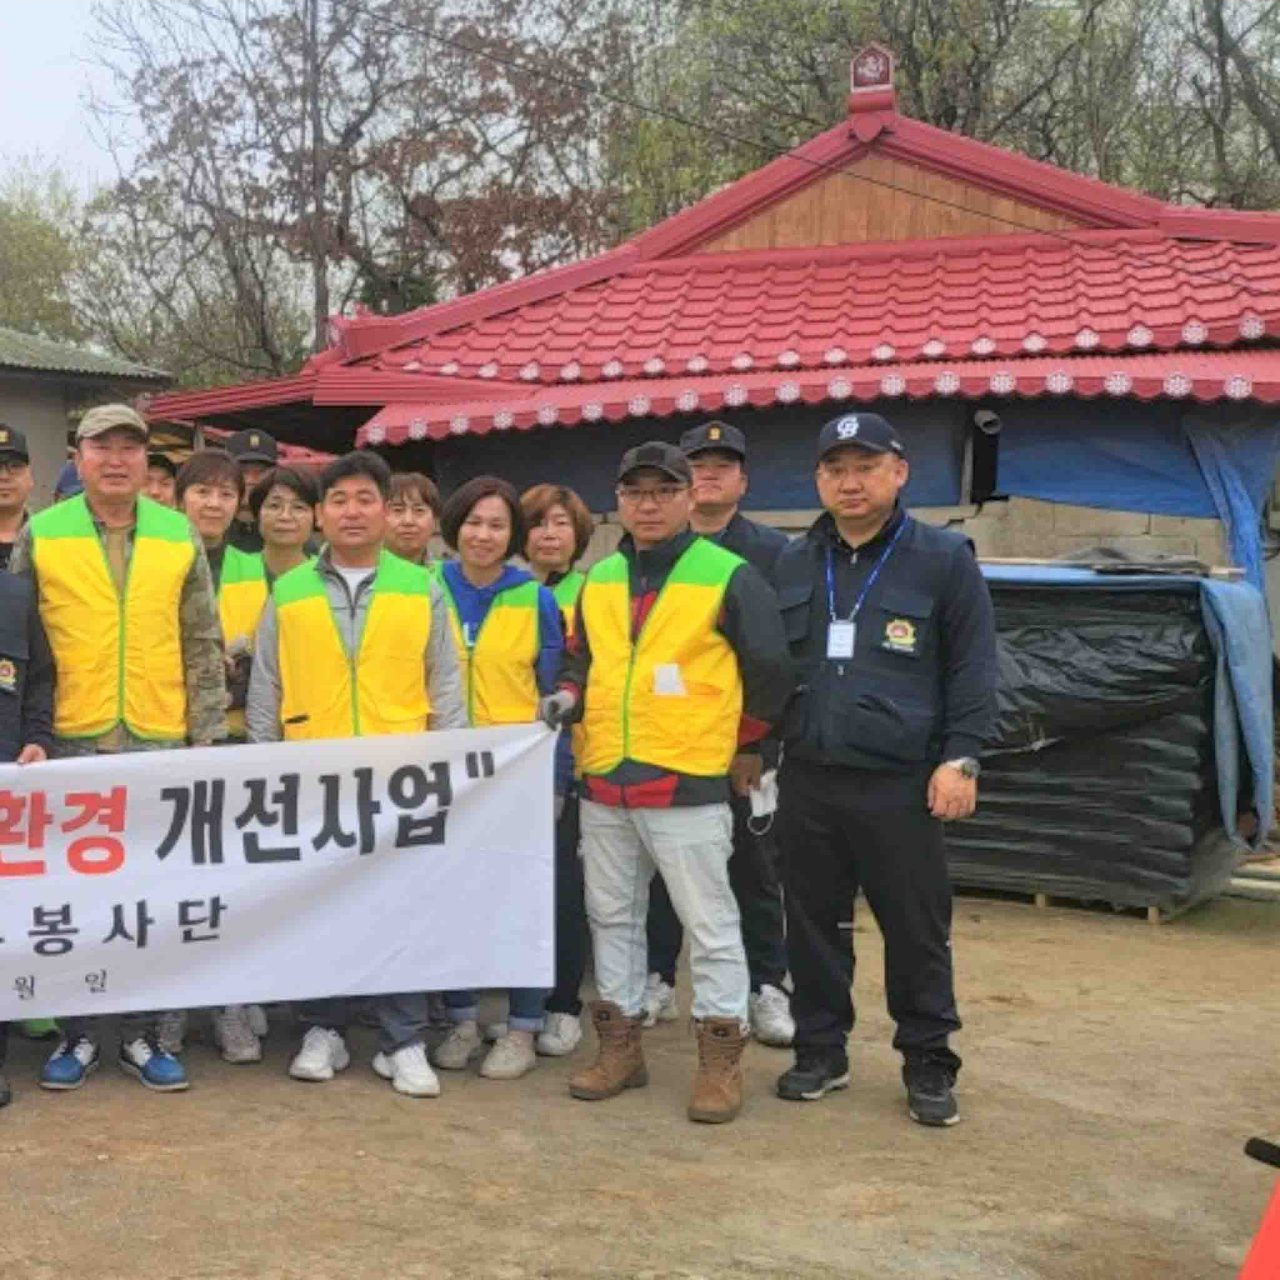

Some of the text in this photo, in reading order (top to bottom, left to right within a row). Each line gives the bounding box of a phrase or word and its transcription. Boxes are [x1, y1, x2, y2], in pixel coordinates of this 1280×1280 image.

[155, 750, 496, 865] 개선사업"
[13, 975, 35, 1000] 월
[83, 969, 109, 994] 일
